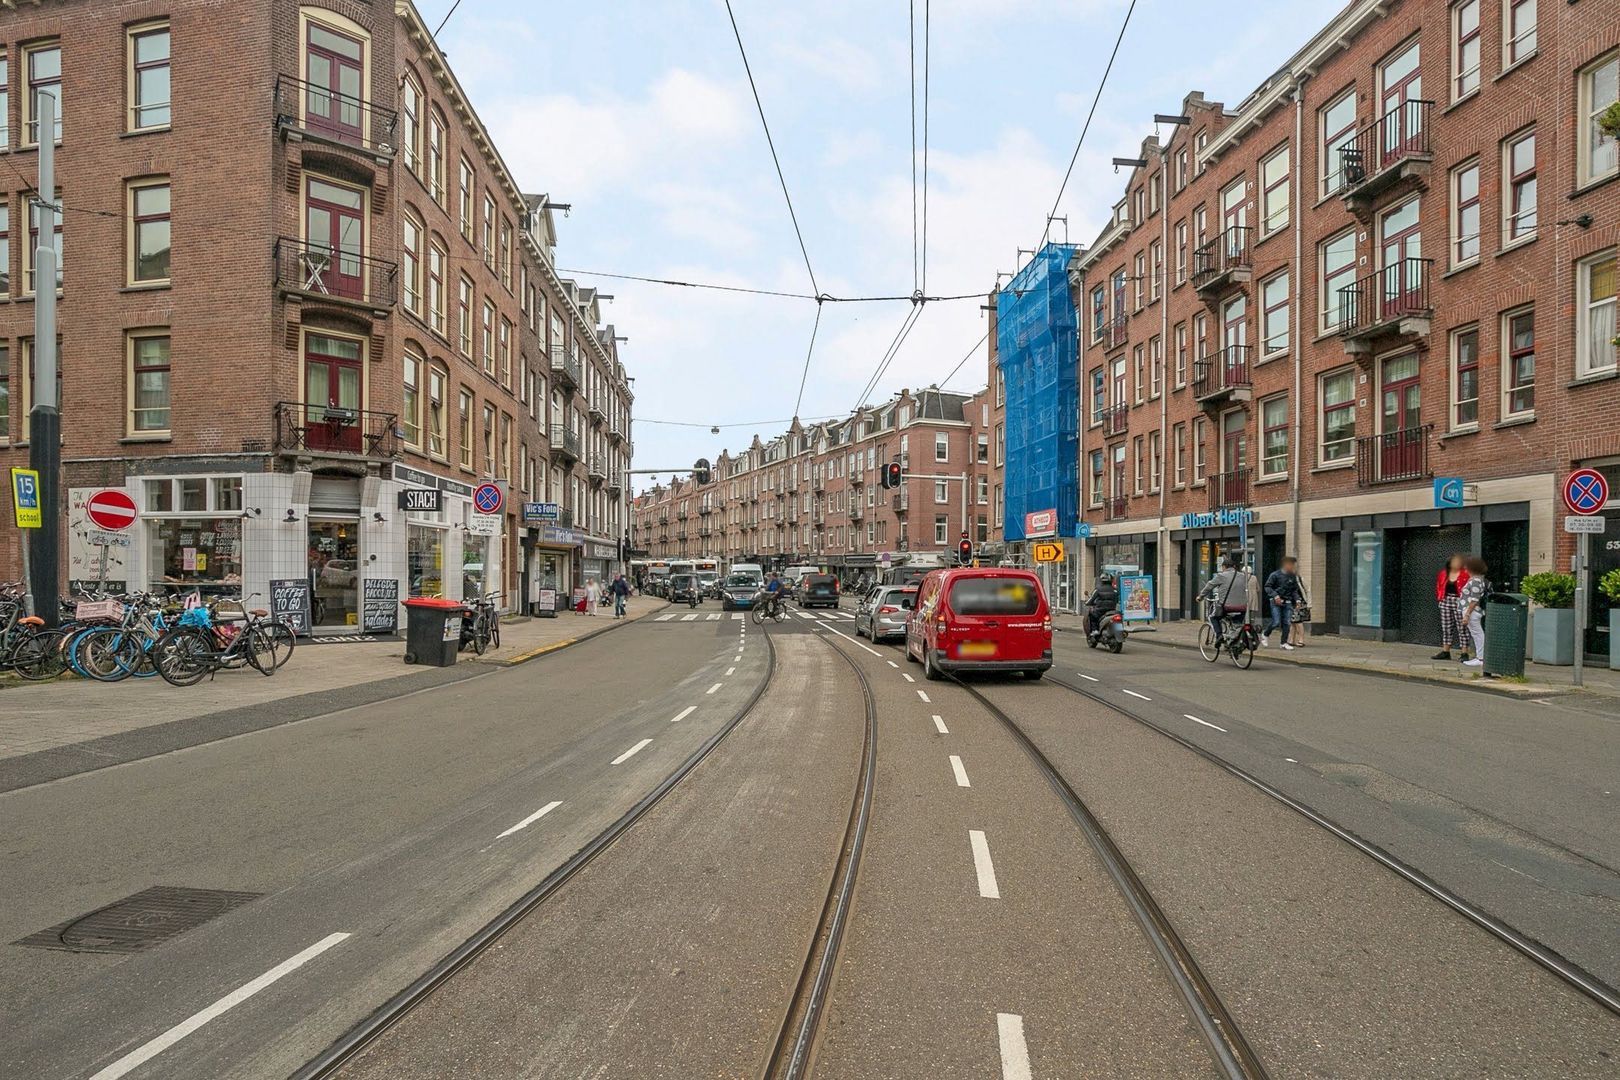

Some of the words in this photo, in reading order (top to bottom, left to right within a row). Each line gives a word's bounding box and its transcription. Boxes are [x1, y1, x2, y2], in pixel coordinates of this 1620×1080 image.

[19, 477, 34, 495] 15
[20, 497, 36, 507] km/h
[407, 491, 437, 508] STACH
[526, 504, 542, 513] Vic's
[543, 504, 557, 513] Foto
[19, 513, 39, 522] school
[1182, 511, 1215, 529] Albert
[1219, 508, 1252, 527] Heijn
[1042, 548, 1051, 558] H
[274, 587, 306, 599] COFFEE
[276, 598, 287, 610] TO
[289, 597, 301, 610] GO
